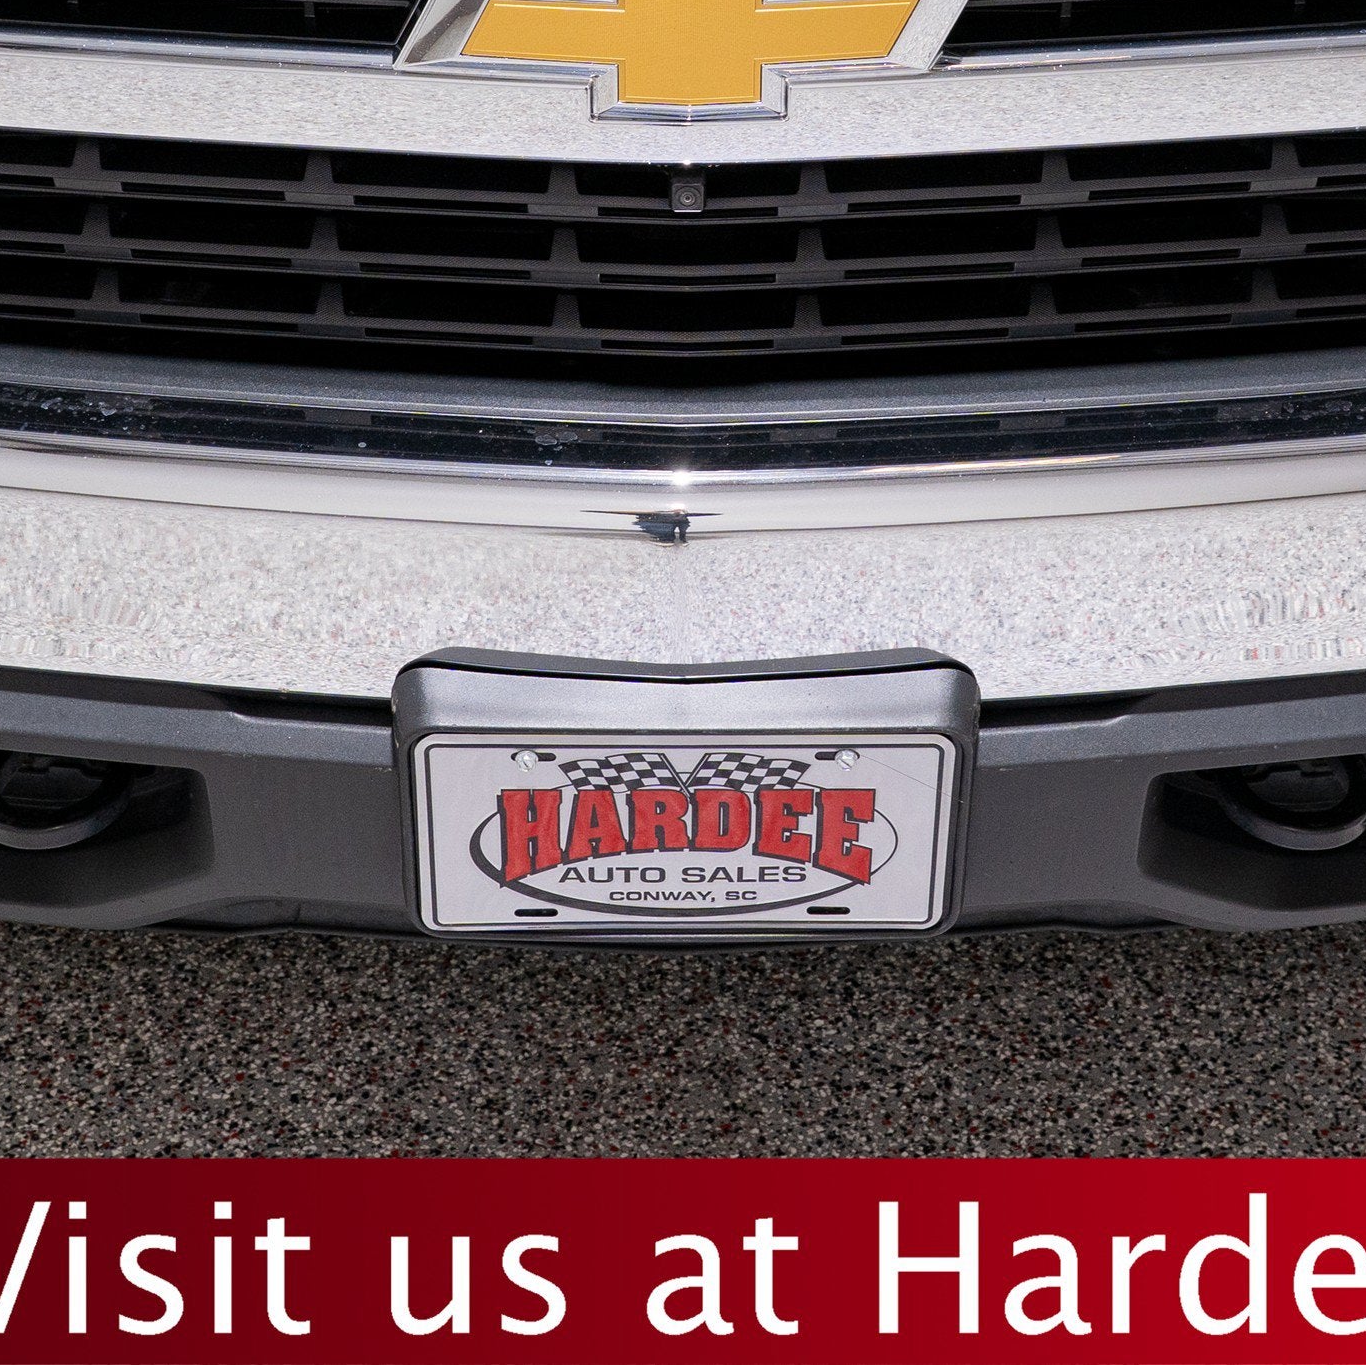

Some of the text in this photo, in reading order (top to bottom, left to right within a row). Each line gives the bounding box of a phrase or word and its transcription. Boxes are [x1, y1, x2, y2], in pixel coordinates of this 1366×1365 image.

[498, 787, 877, 887] HARDEE
[559, 866, 807, 883] AUTO SALES
[609, 890, 757, 903] CONWAY, SC
